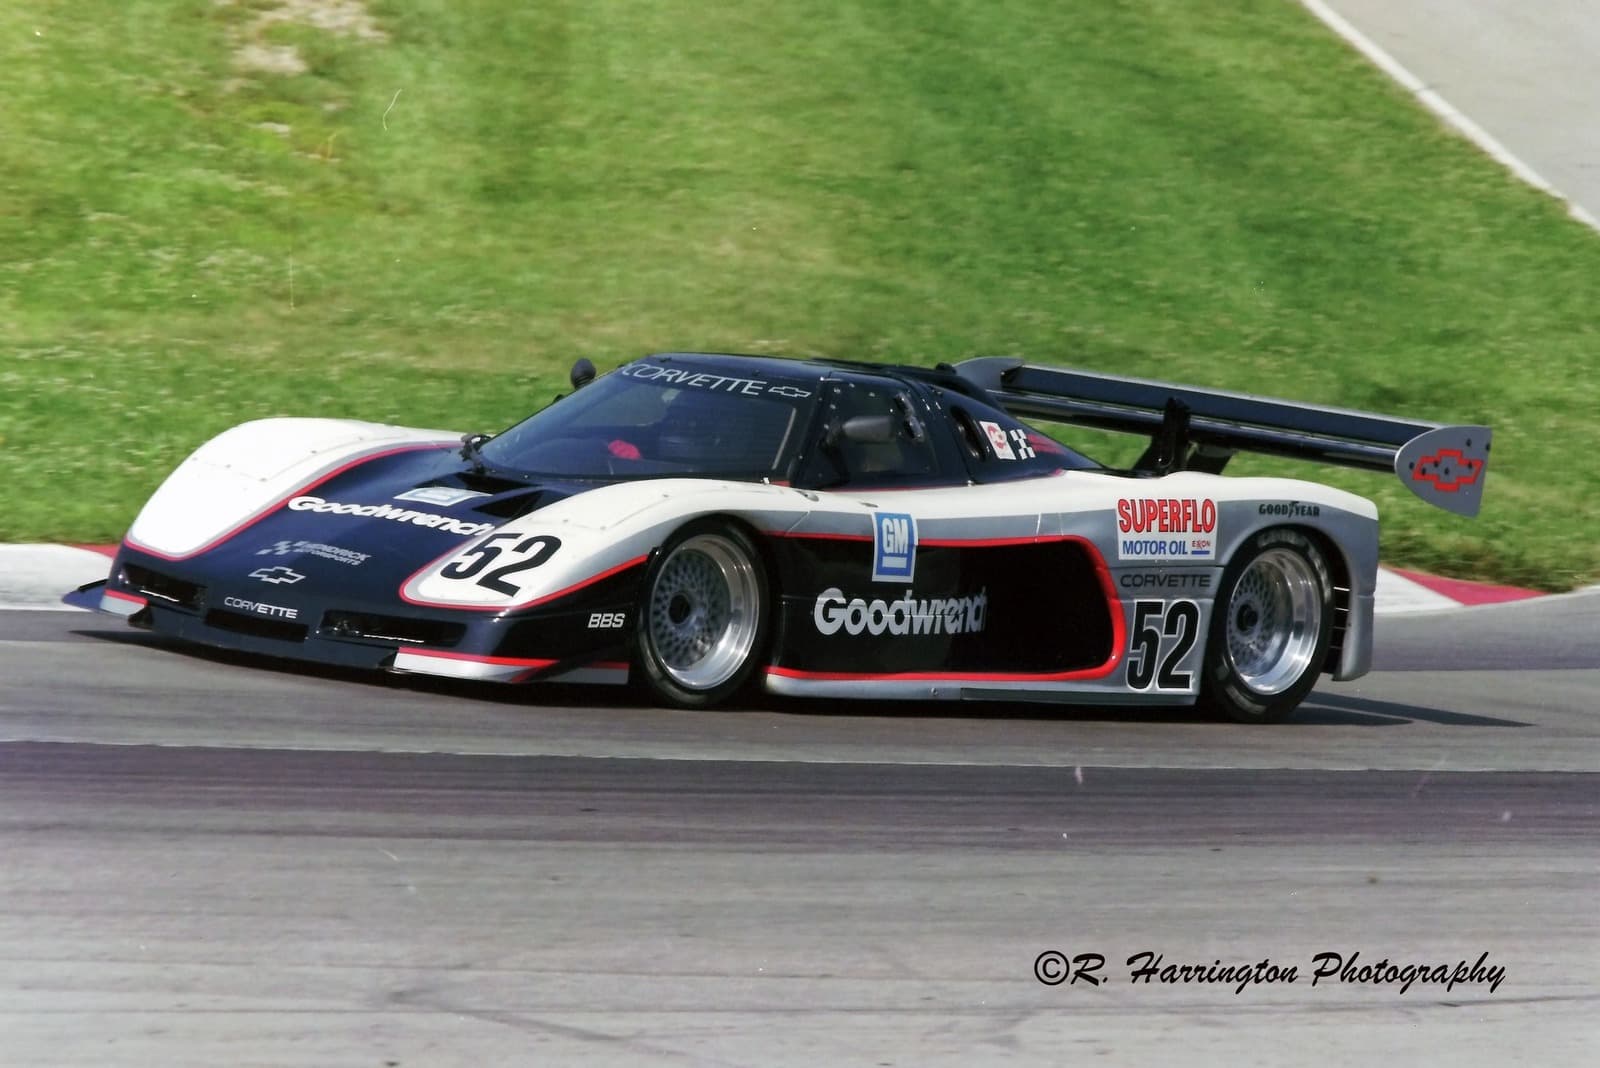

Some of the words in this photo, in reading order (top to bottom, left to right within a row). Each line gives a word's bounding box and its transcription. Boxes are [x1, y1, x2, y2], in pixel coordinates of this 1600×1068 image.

[622, 363, 767, 396] CORVETTE
[288, 495, 497, 536] Goodwrench
[1117, 498, 1216, 533] SUPERFLO
[1258, 501, 1321, 518] GOODYEAR
[881, 517, 909, 554] GM
[1122, 540, 1166, 555] MOTOR
[1169, 541, 1188, 555] OIL
[440, 532, 563, 597] 52
[1119, 574, 1212, 588] CORVETTE
[224, 596, 298, 620] CORVETTE
[587, 612, 626, 629] BBS
[1127, 598, 1201, 692] 52
